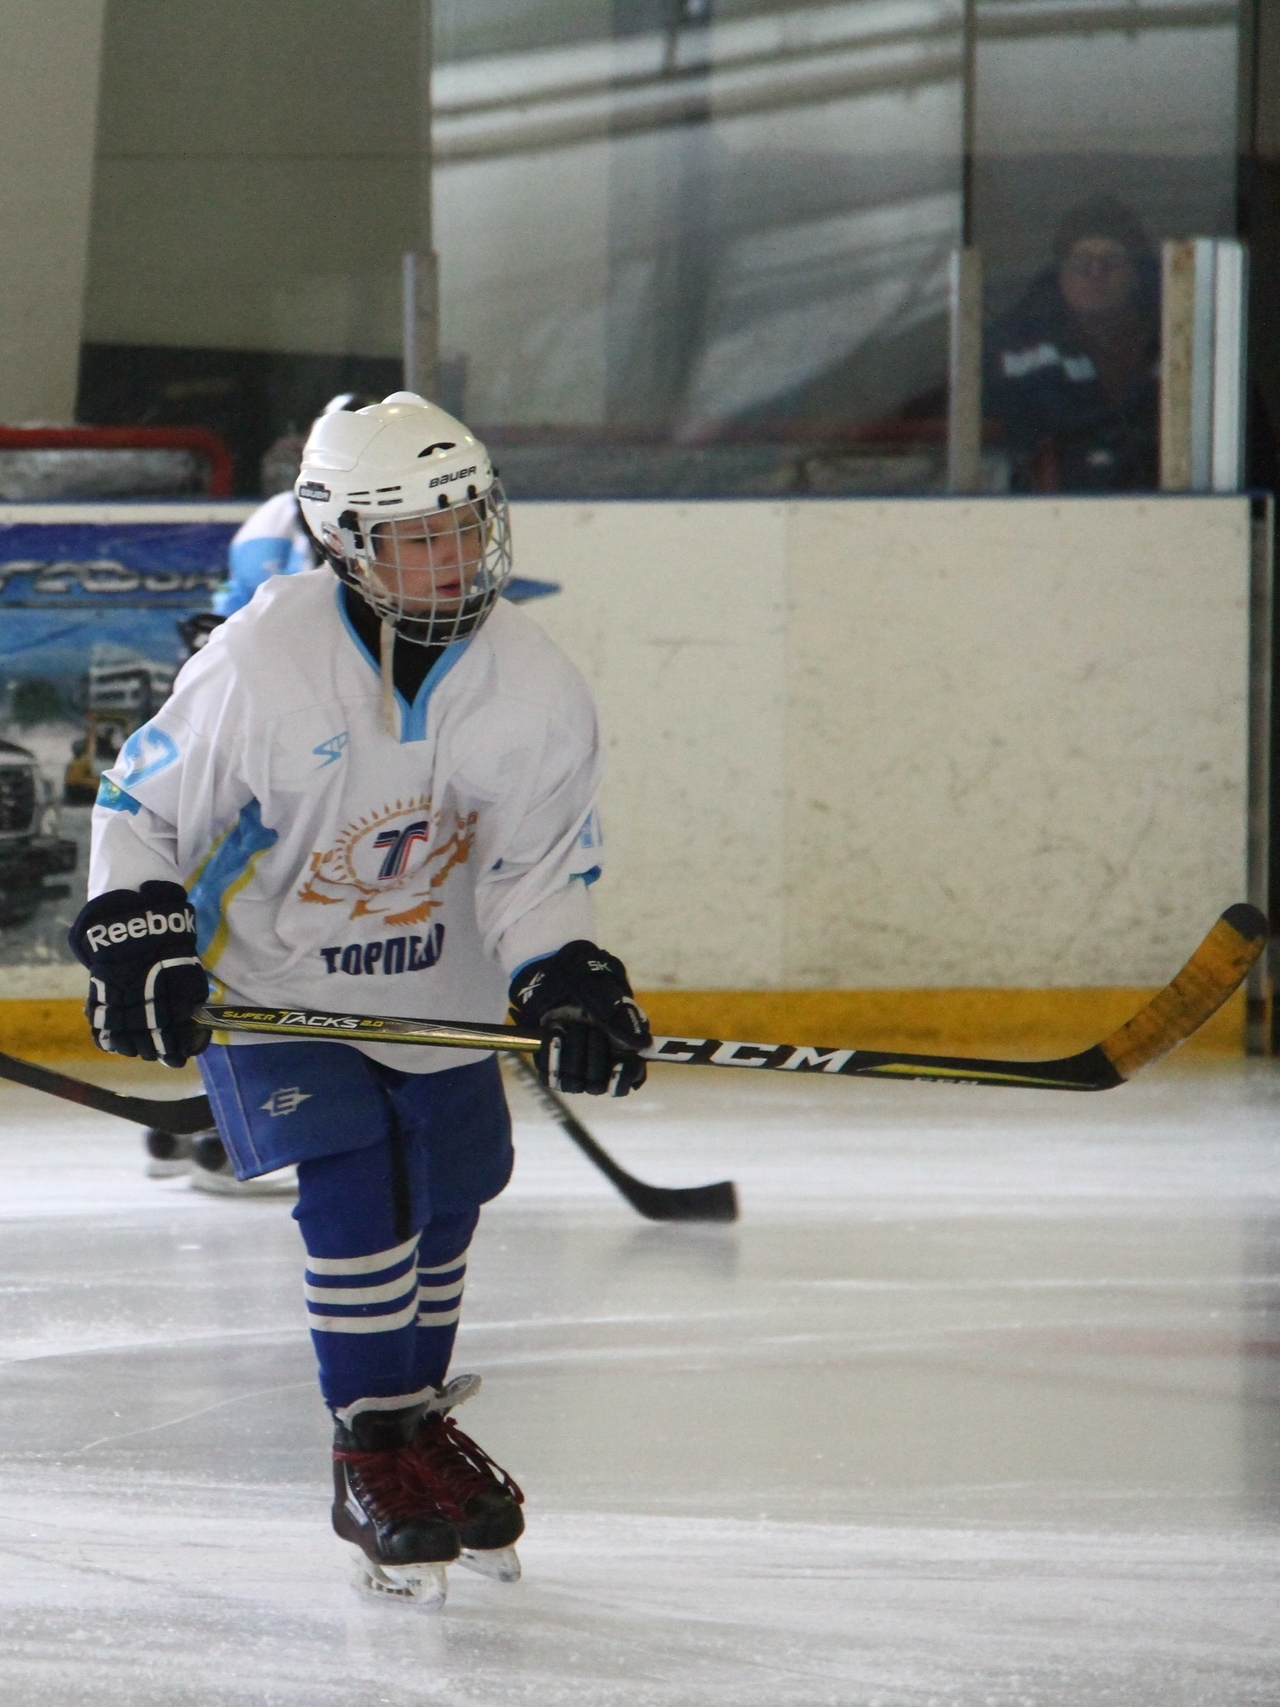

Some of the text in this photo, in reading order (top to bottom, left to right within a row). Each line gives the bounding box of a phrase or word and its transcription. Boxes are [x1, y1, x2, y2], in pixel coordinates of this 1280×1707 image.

[428, 465, 477, 489] BAUER
[86, 908, 195, 954] Reebok
[222, 1010, 276, 1021] SUPER
[276, 1010, 360, 1029] TACKS
[639, 1036, 857, 1073] CCM
